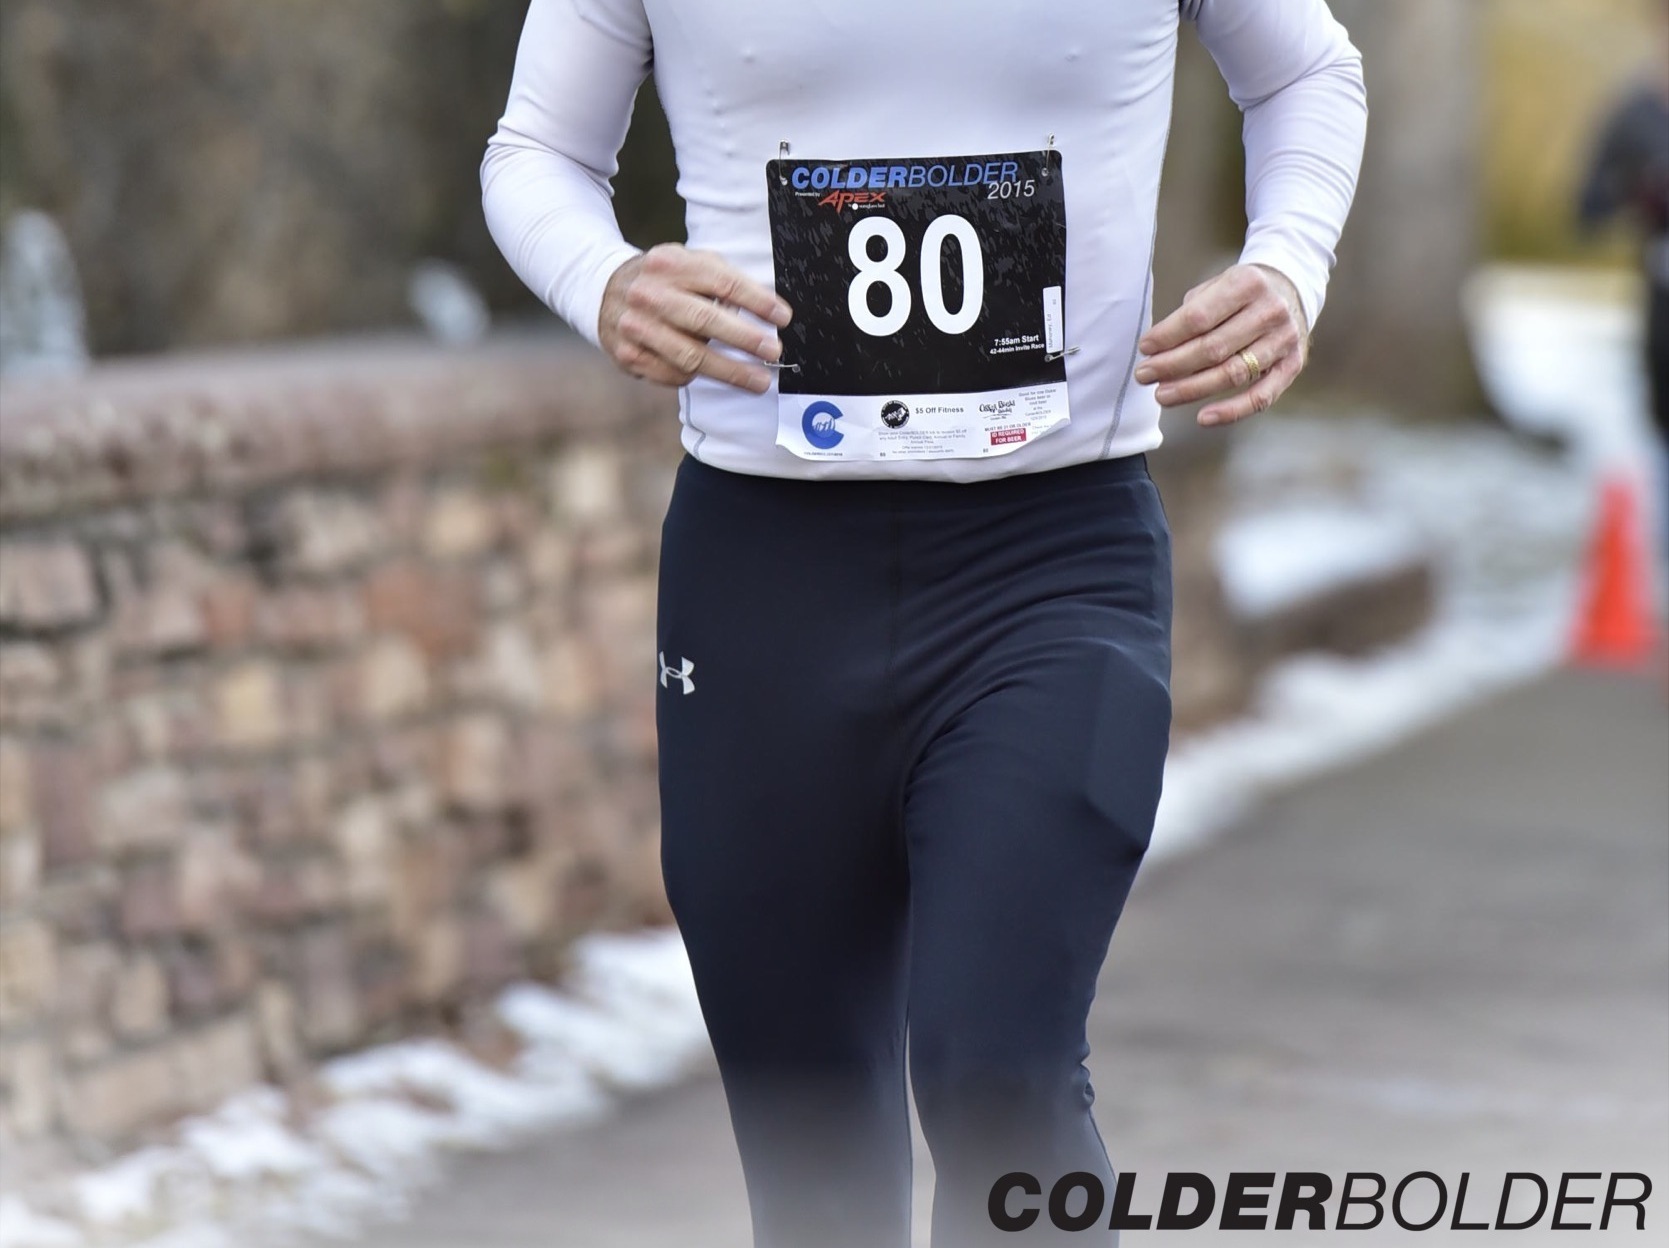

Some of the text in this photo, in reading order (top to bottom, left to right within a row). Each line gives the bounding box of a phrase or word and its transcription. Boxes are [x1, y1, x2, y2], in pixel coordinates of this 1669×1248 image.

[791, 161, 1018, 190] COLDERBOLDER
[987, 179, 1036, 200] 2015
[818, 190, 887, 215] APEX
[847, 214, 984, 337] 80
[994, 334, 1039, 346] 7:55am Start
[989, 345, 1015, 355] 42-44min
[937, 406, 964, 414] Fitness
[998, 428, 1025, 436] REQUIRED
[1007, 435, 1022, 443] BEER
